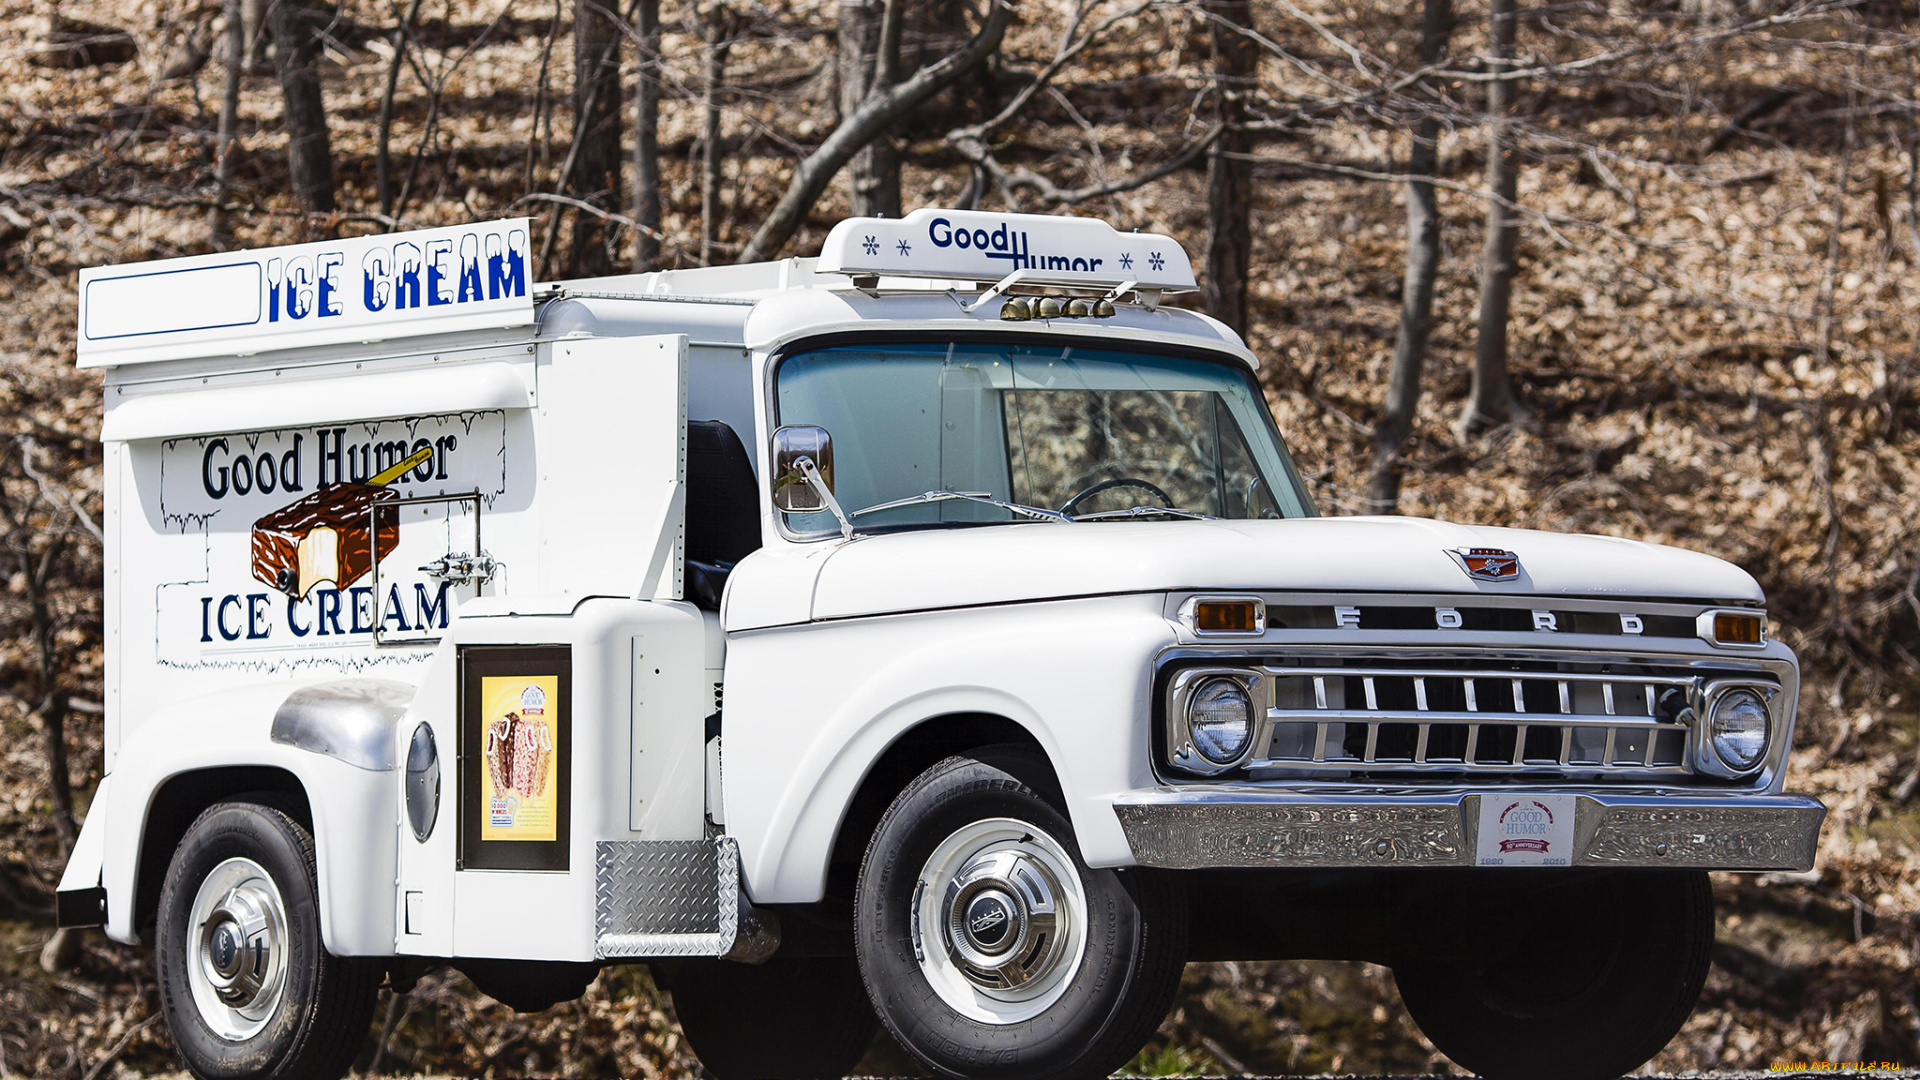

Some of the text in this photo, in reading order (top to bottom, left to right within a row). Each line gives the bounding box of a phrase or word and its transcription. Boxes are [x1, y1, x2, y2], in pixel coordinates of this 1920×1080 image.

[929, 217, 1103, 272] Good Humor
[266, 229, 526, 323] ICE CREAM
[202, 428, 457, 500] Good Humor
[200, 581, 450, 642] ICE CREAM
[1334, 606, 1644, 634] FORD
[1506, 823, 1547, 835] HUMOR
[1510, 811, 1542, 823] GOOD
[1092, 899, 1116, 994] COMMERCIAL
